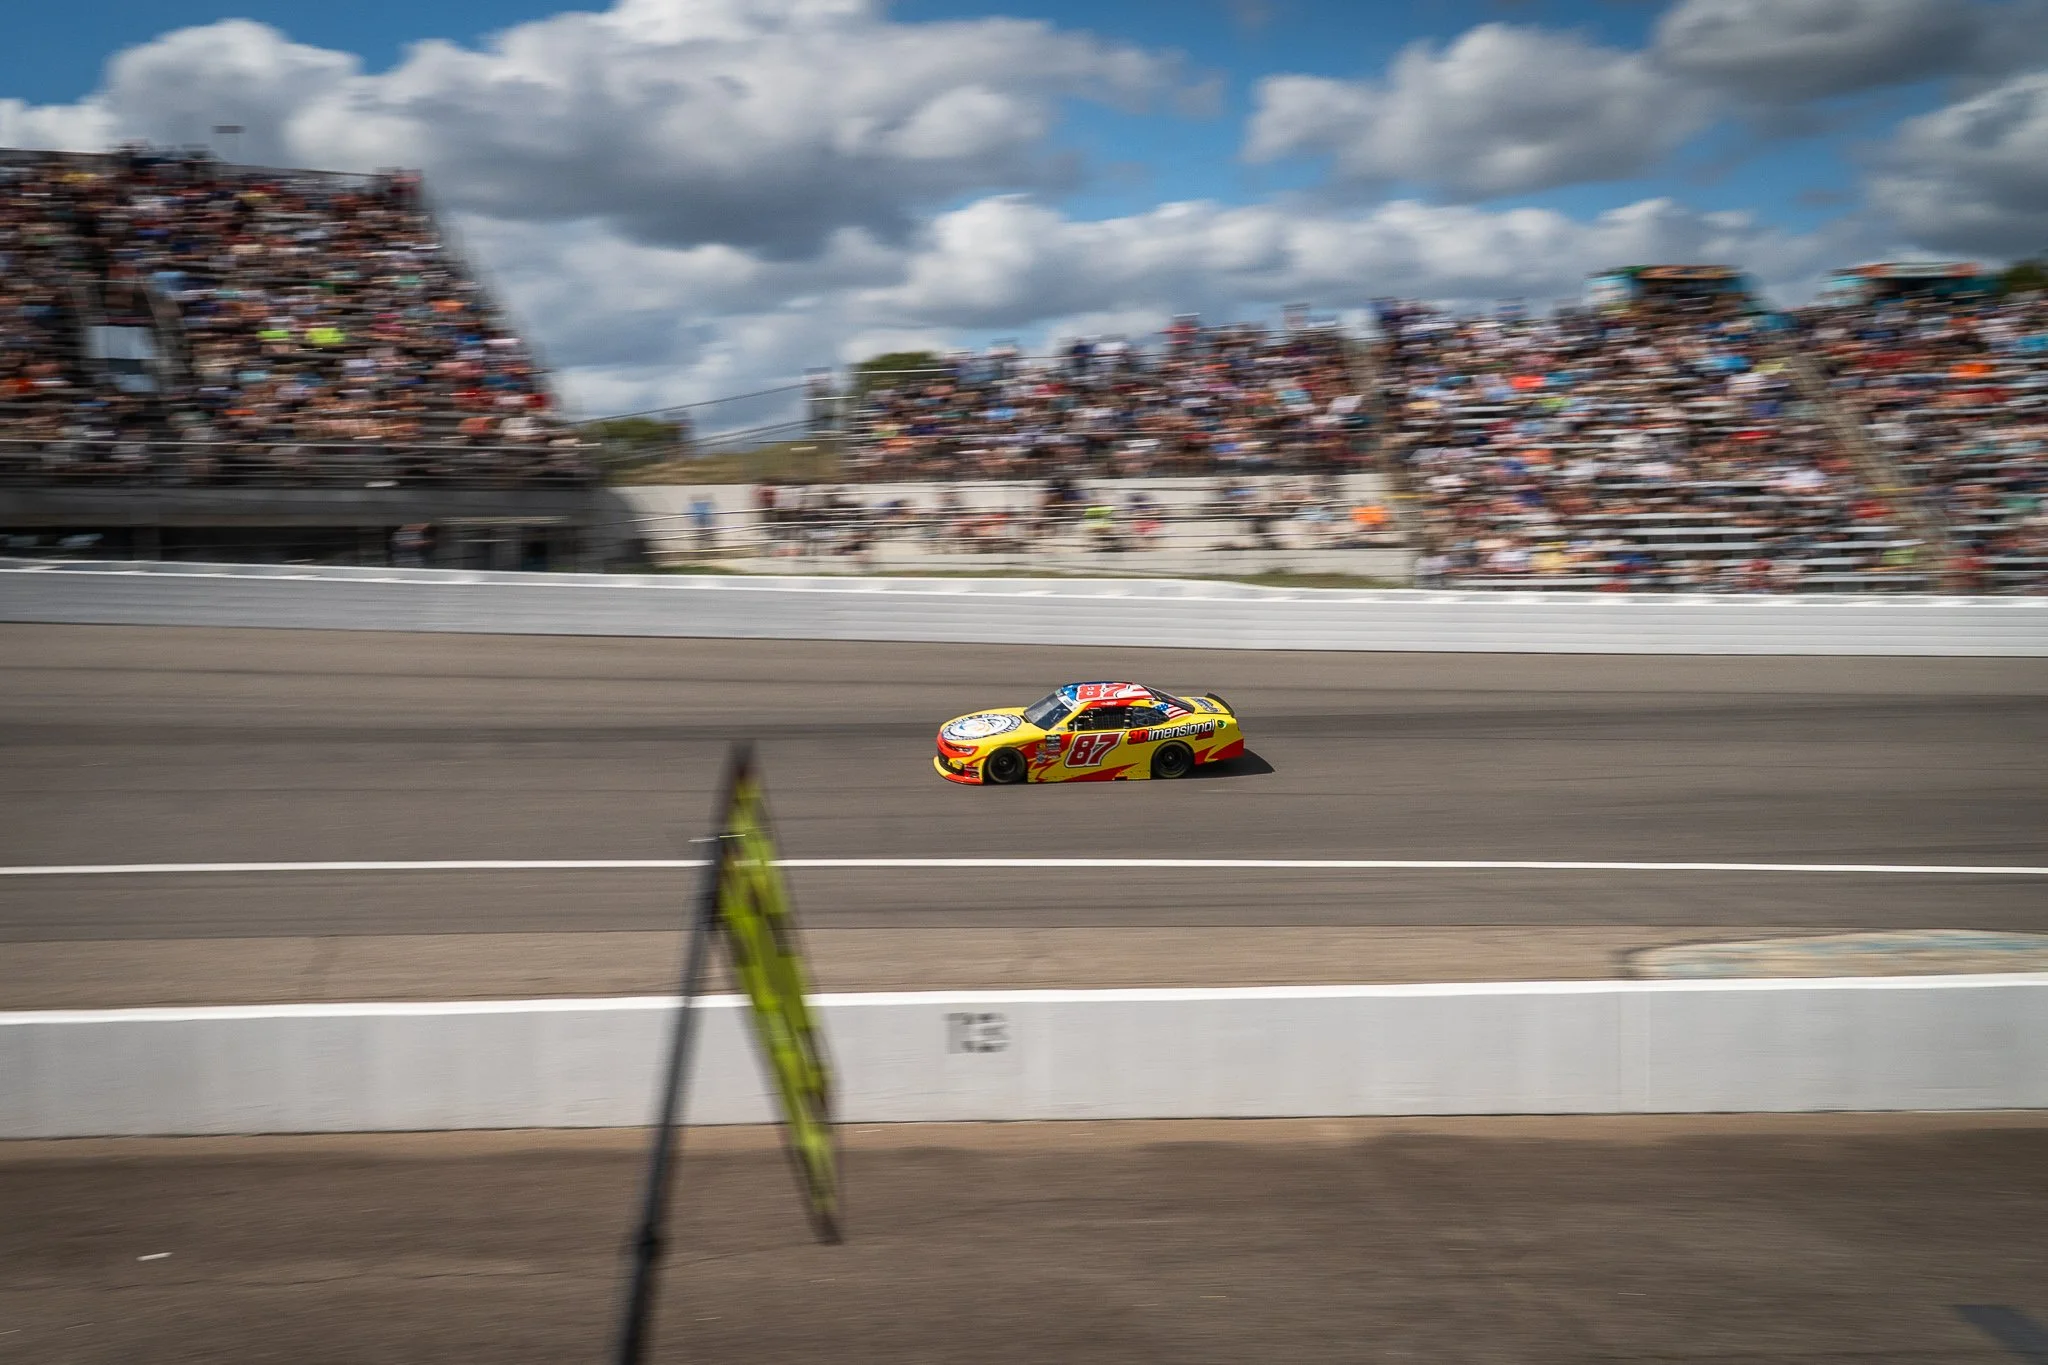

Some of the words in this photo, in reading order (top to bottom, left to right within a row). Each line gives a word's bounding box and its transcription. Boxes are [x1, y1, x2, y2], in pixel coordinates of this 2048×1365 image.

[1077, 684, 1129, 702] 87
[1127, 719, 1216, 745] 3Dimensional
[1065, 732, 1125, 768] 87
